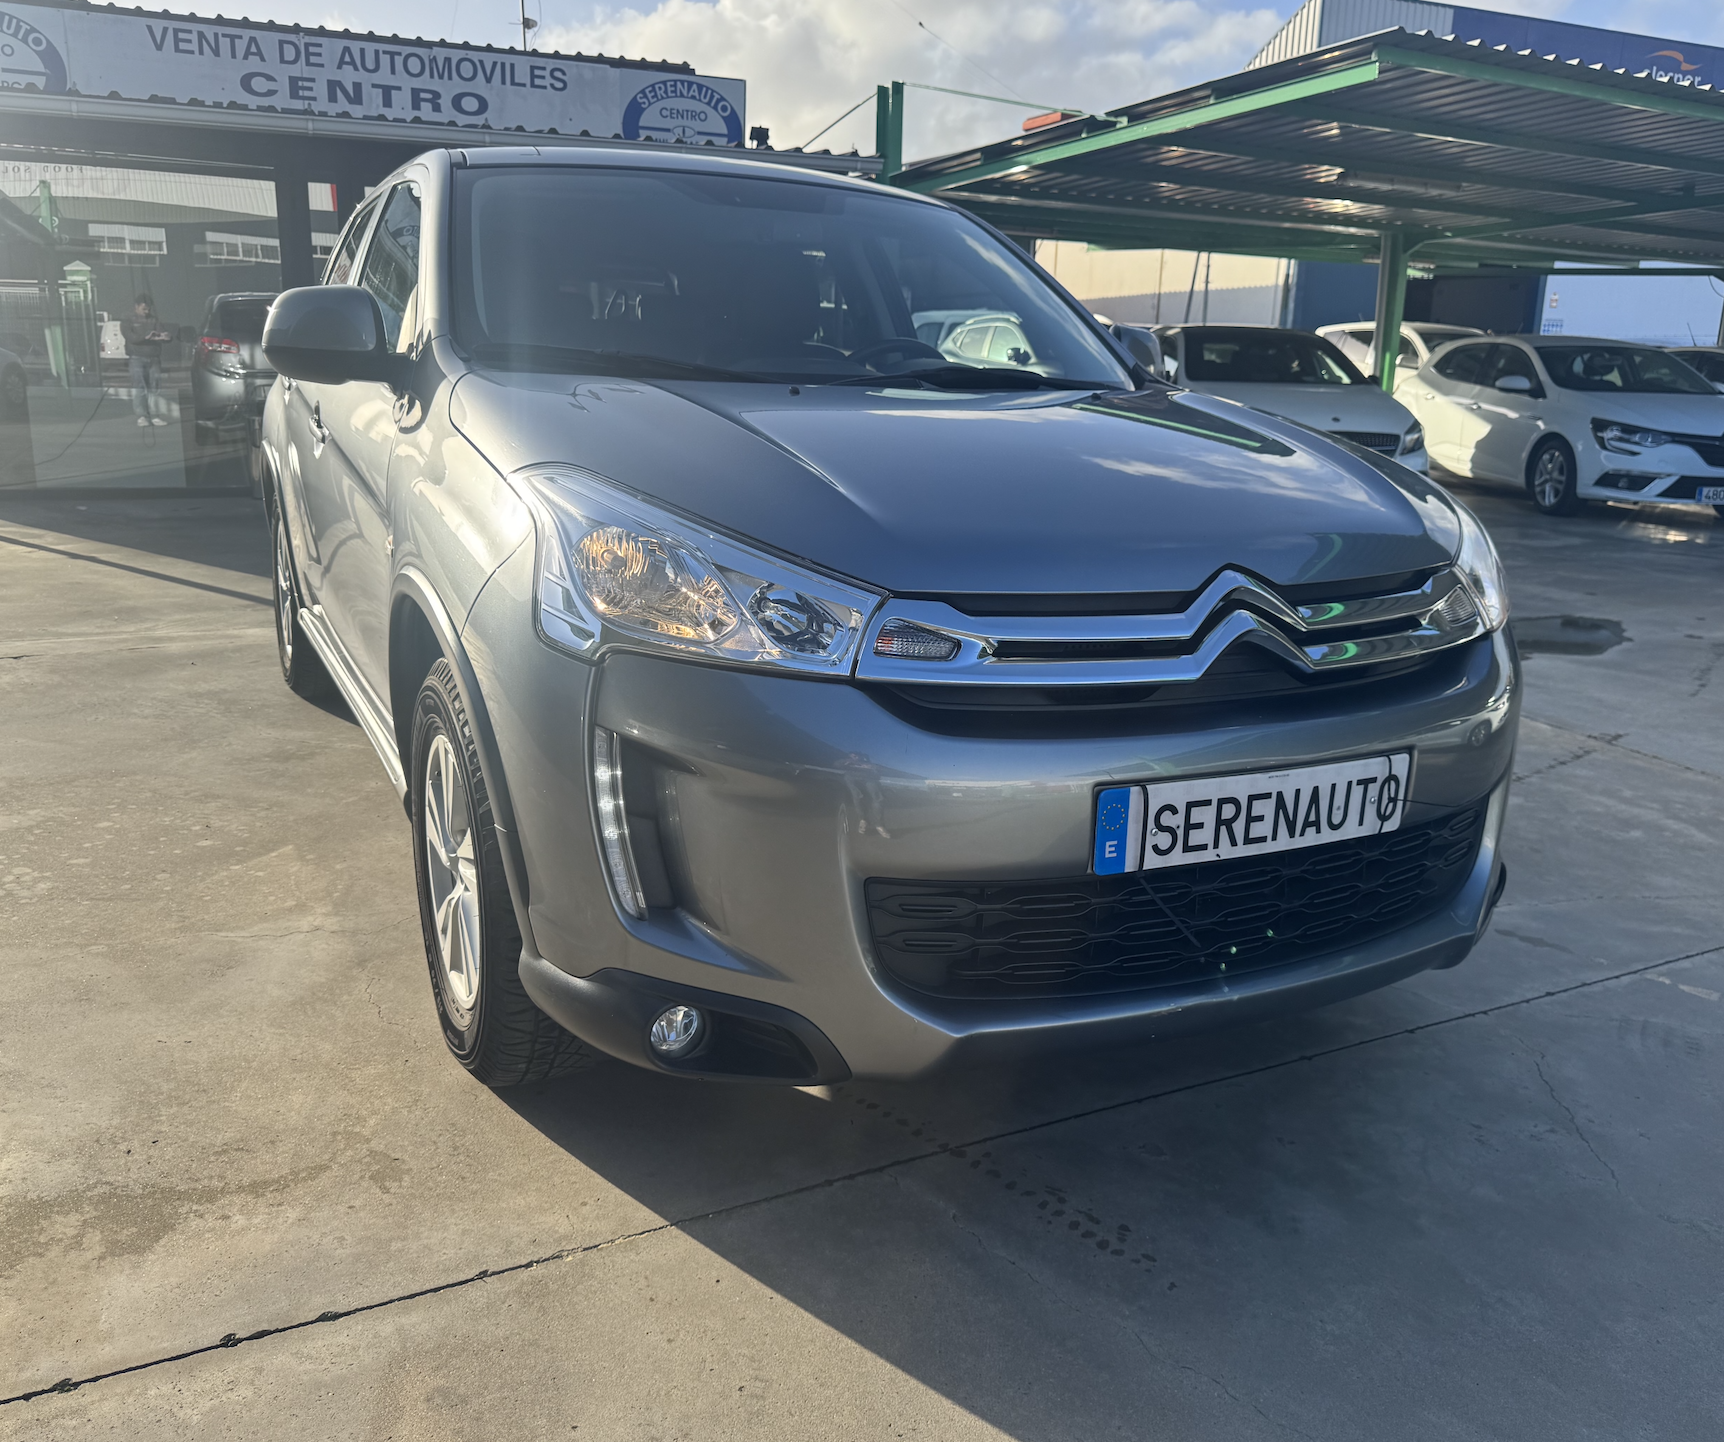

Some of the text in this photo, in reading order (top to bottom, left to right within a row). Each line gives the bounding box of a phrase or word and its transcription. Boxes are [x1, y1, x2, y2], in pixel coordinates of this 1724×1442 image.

[0, 15, 47, 51] UTO
[146, 24, 568, 92] VENTA DE AUTOMOVILES
[240, 71, 489, 117] CENTRO
[636, 81, 732, 117] SERENAUTO
[659, 107, 708, 122] CENTRO
[1151, 774, 1400, 856] SERENAUTO
[1104, 840, 1118, 858] E
